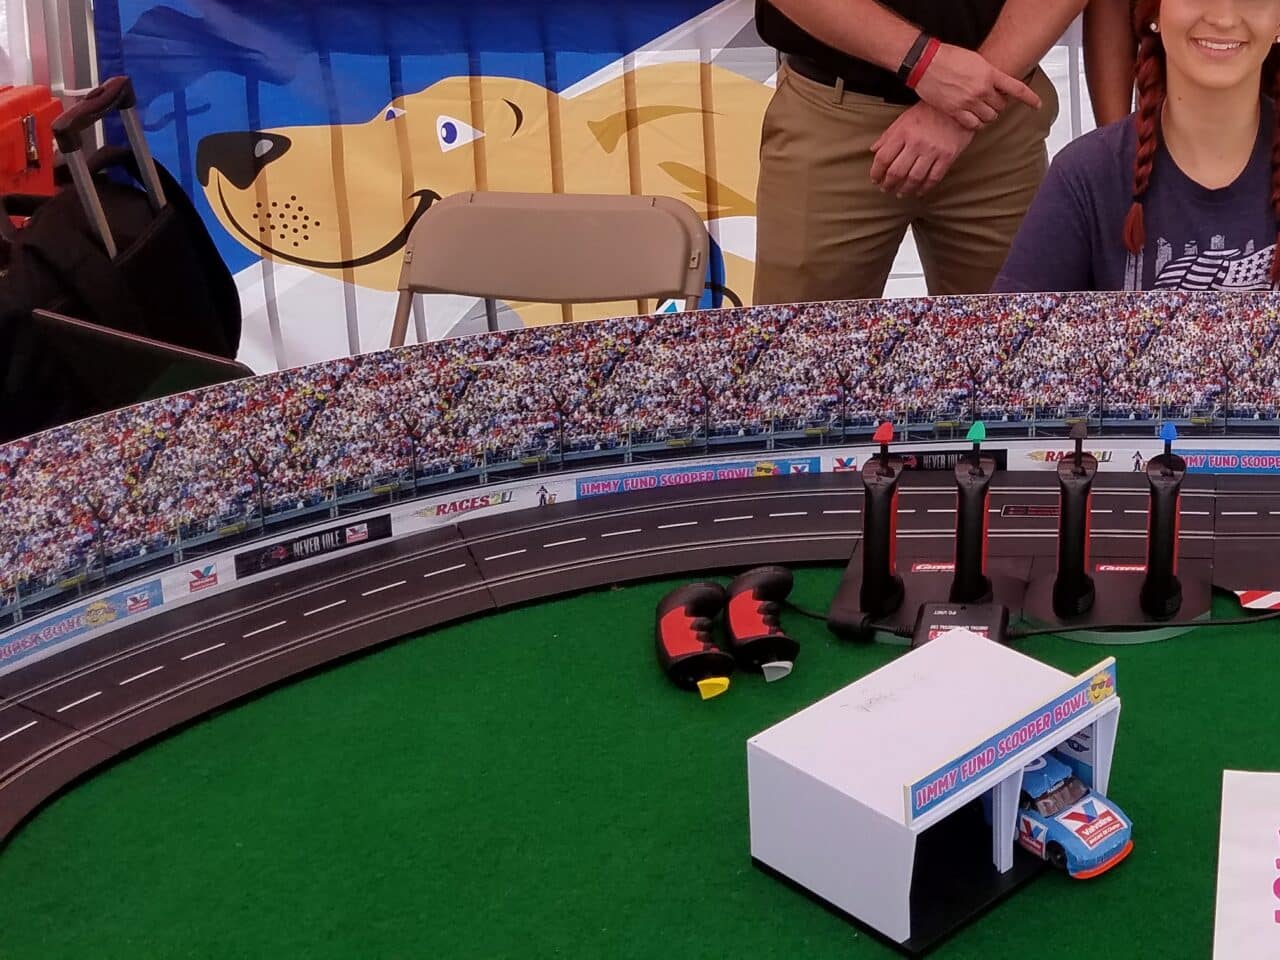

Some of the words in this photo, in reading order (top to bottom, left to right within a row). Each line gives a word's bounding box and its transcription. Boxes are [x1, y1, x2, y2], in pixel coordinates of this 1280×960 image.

[1183, 454, 1206, 469] MMY
[1208, 454, 1238, 469] FUND
[580, 480, 620, 496] JIMMY
[623, 476, 657, 491] FUND
[660, 470, 714, 487] SCOOPER
[293, 535, 321, 557] NEVER
[915, 768, 957, 808] JIMMY
[960, 746, 995, 781] FUND
[998, 711, 1052, 758] SCOOPER
[1054, 691, 1088, 724] BOWL
